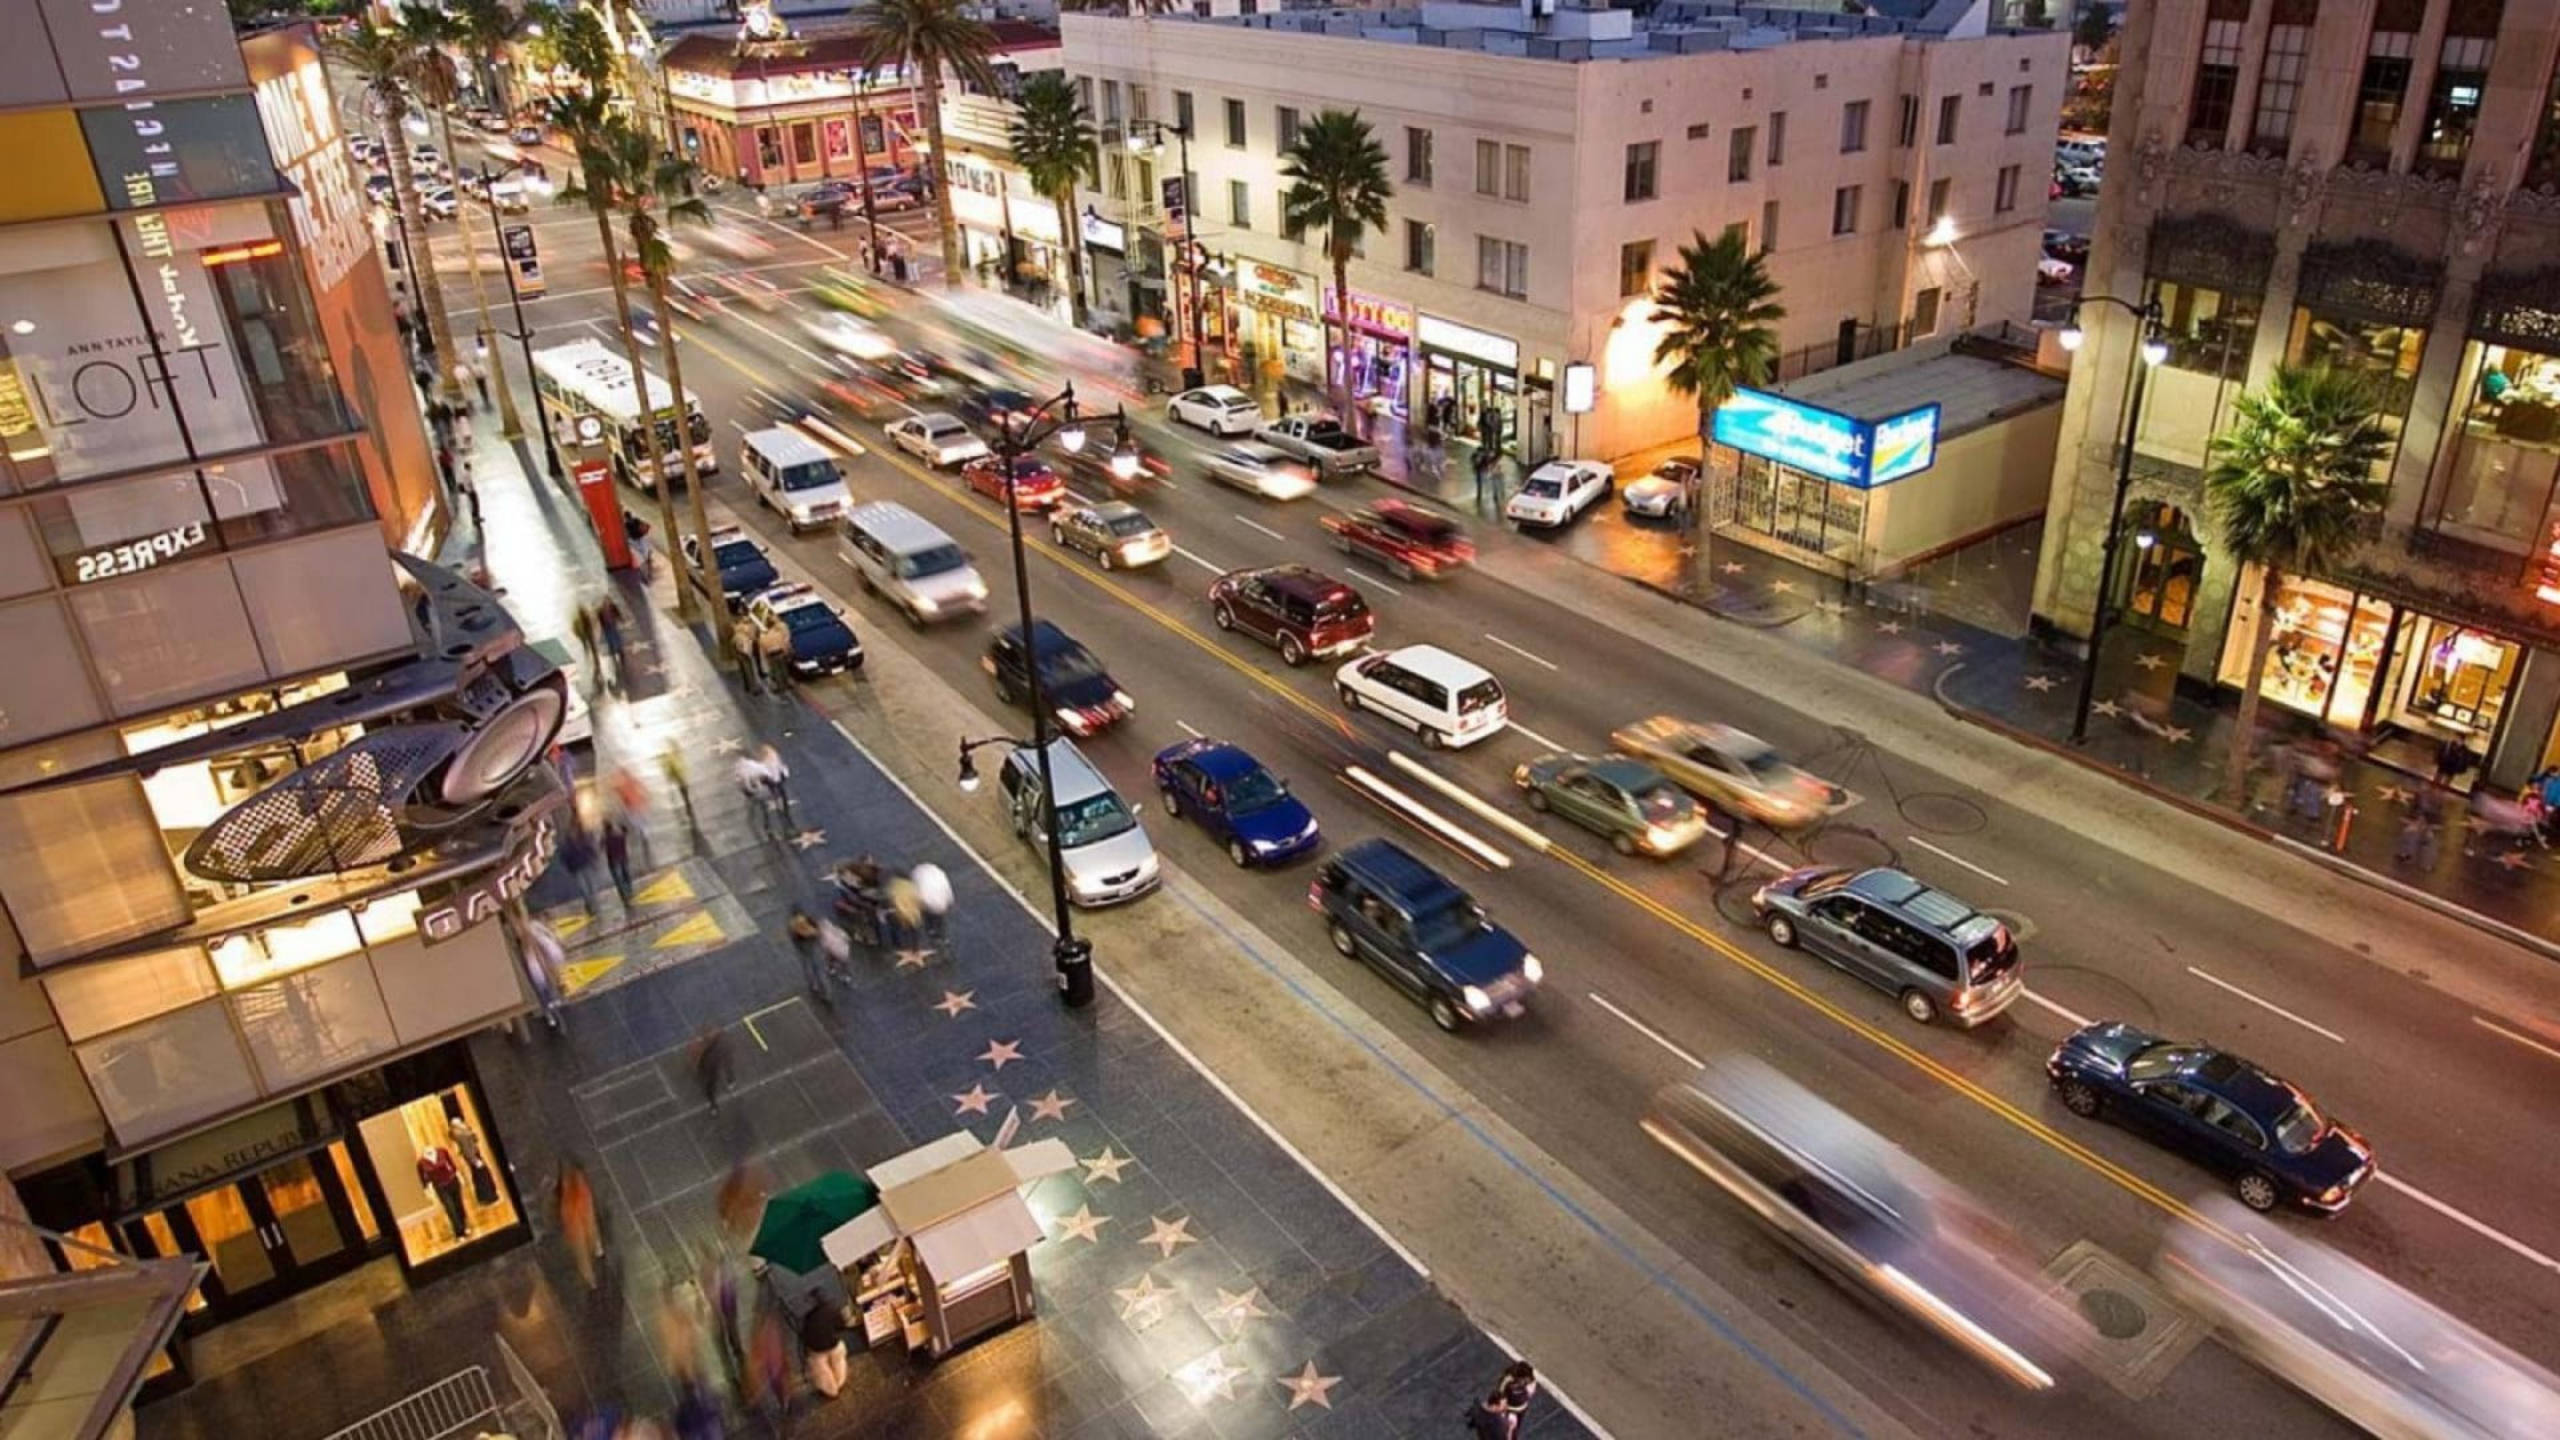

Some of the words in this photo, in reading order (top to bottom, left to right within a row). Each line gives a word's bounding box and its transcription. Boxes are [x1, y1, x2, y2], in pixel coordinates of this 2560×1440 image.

[68, 342, 102, 355] ANN
[105, 331, 166, 348] TAYLR
[32, 343, 220, 427] LOFT
